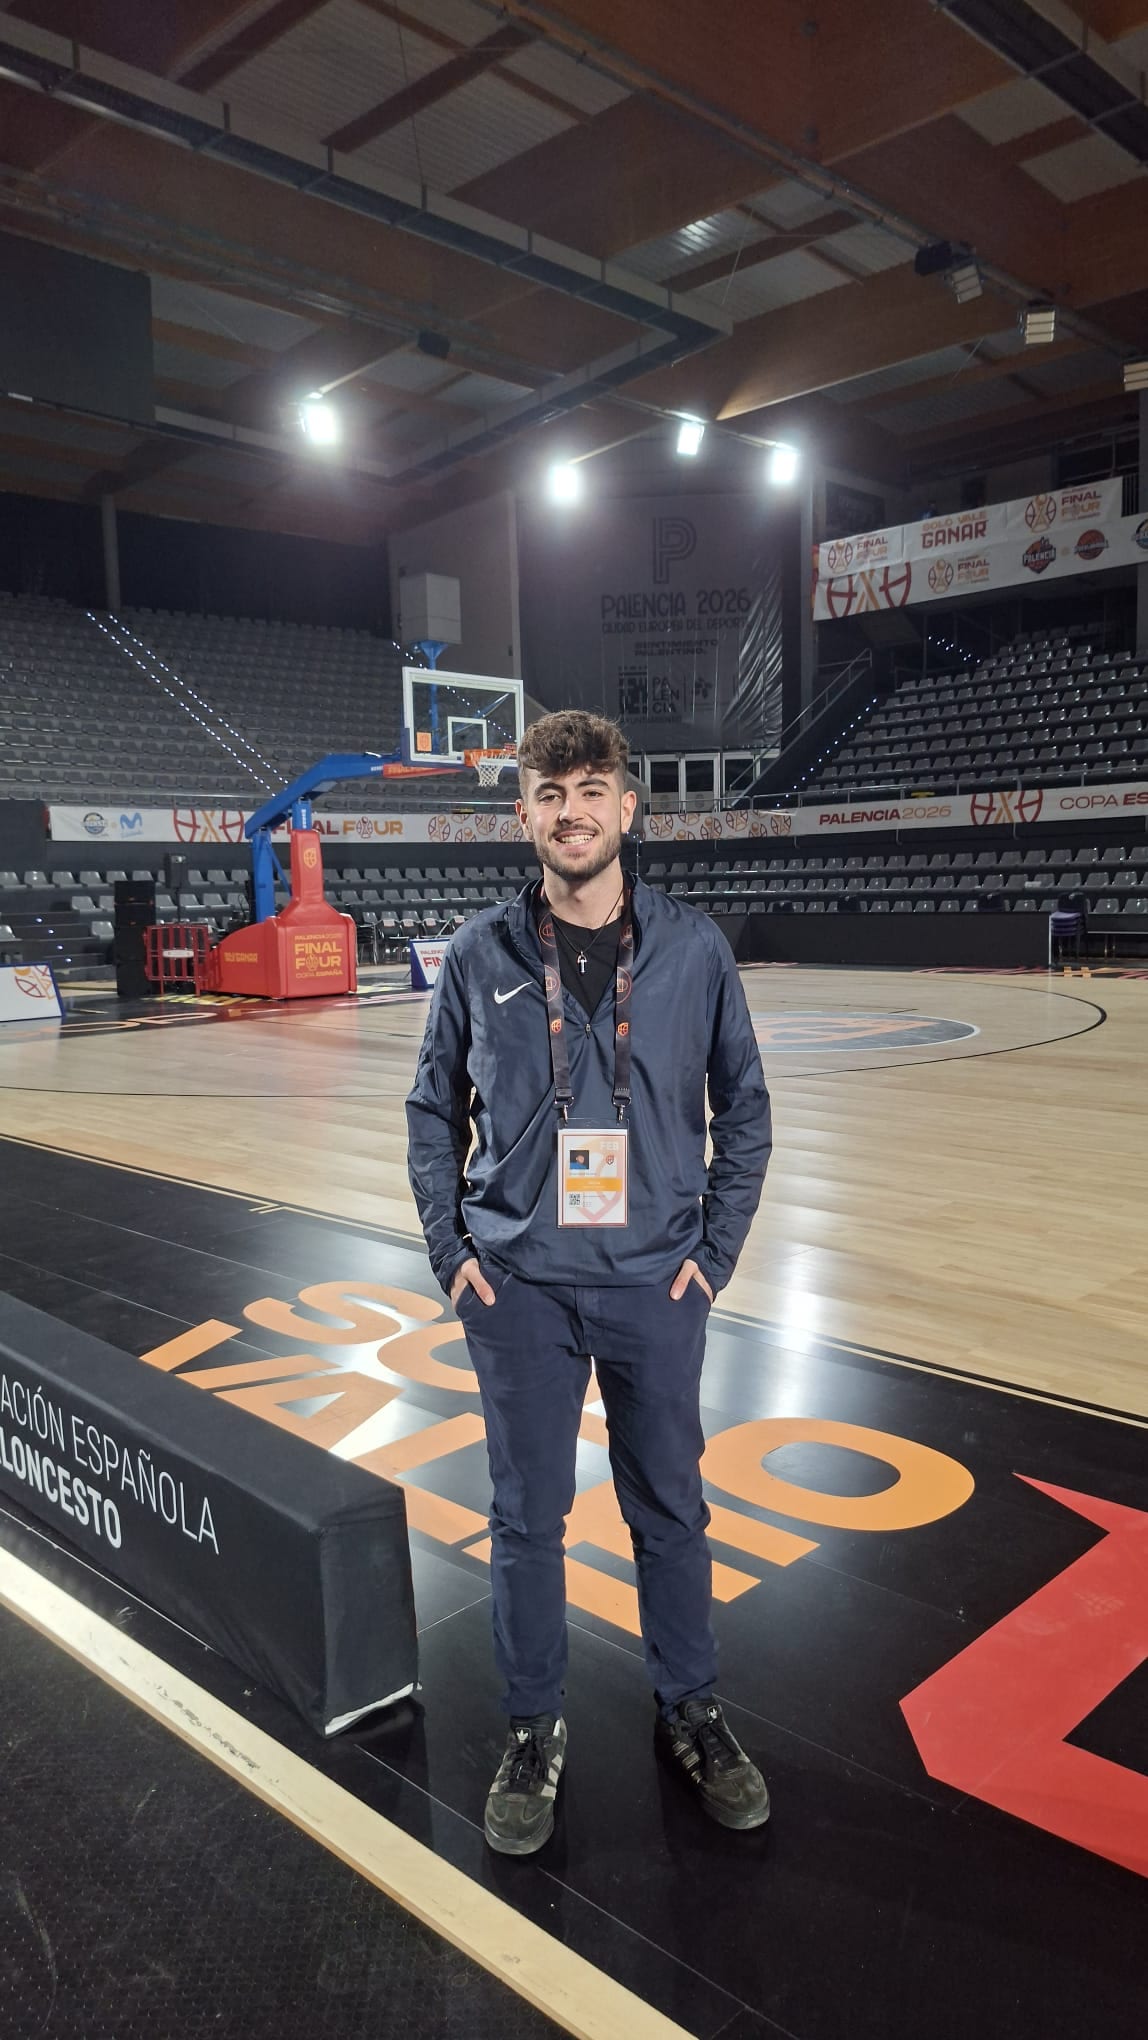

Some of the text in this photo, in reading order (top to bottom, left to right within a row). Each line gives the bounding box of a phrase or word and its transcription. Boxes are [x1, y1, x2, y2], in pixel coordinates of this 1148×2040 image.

[921, 519, 989, 549] GANAR
[601, 589, 752, 619] PALENCIA 2026
[1060, 794, 1118, 810] COPA
[294, 942, 343, 955] FINAL
[0, 1374, 220, 1556] ACIÓN ESPAÑOLA
